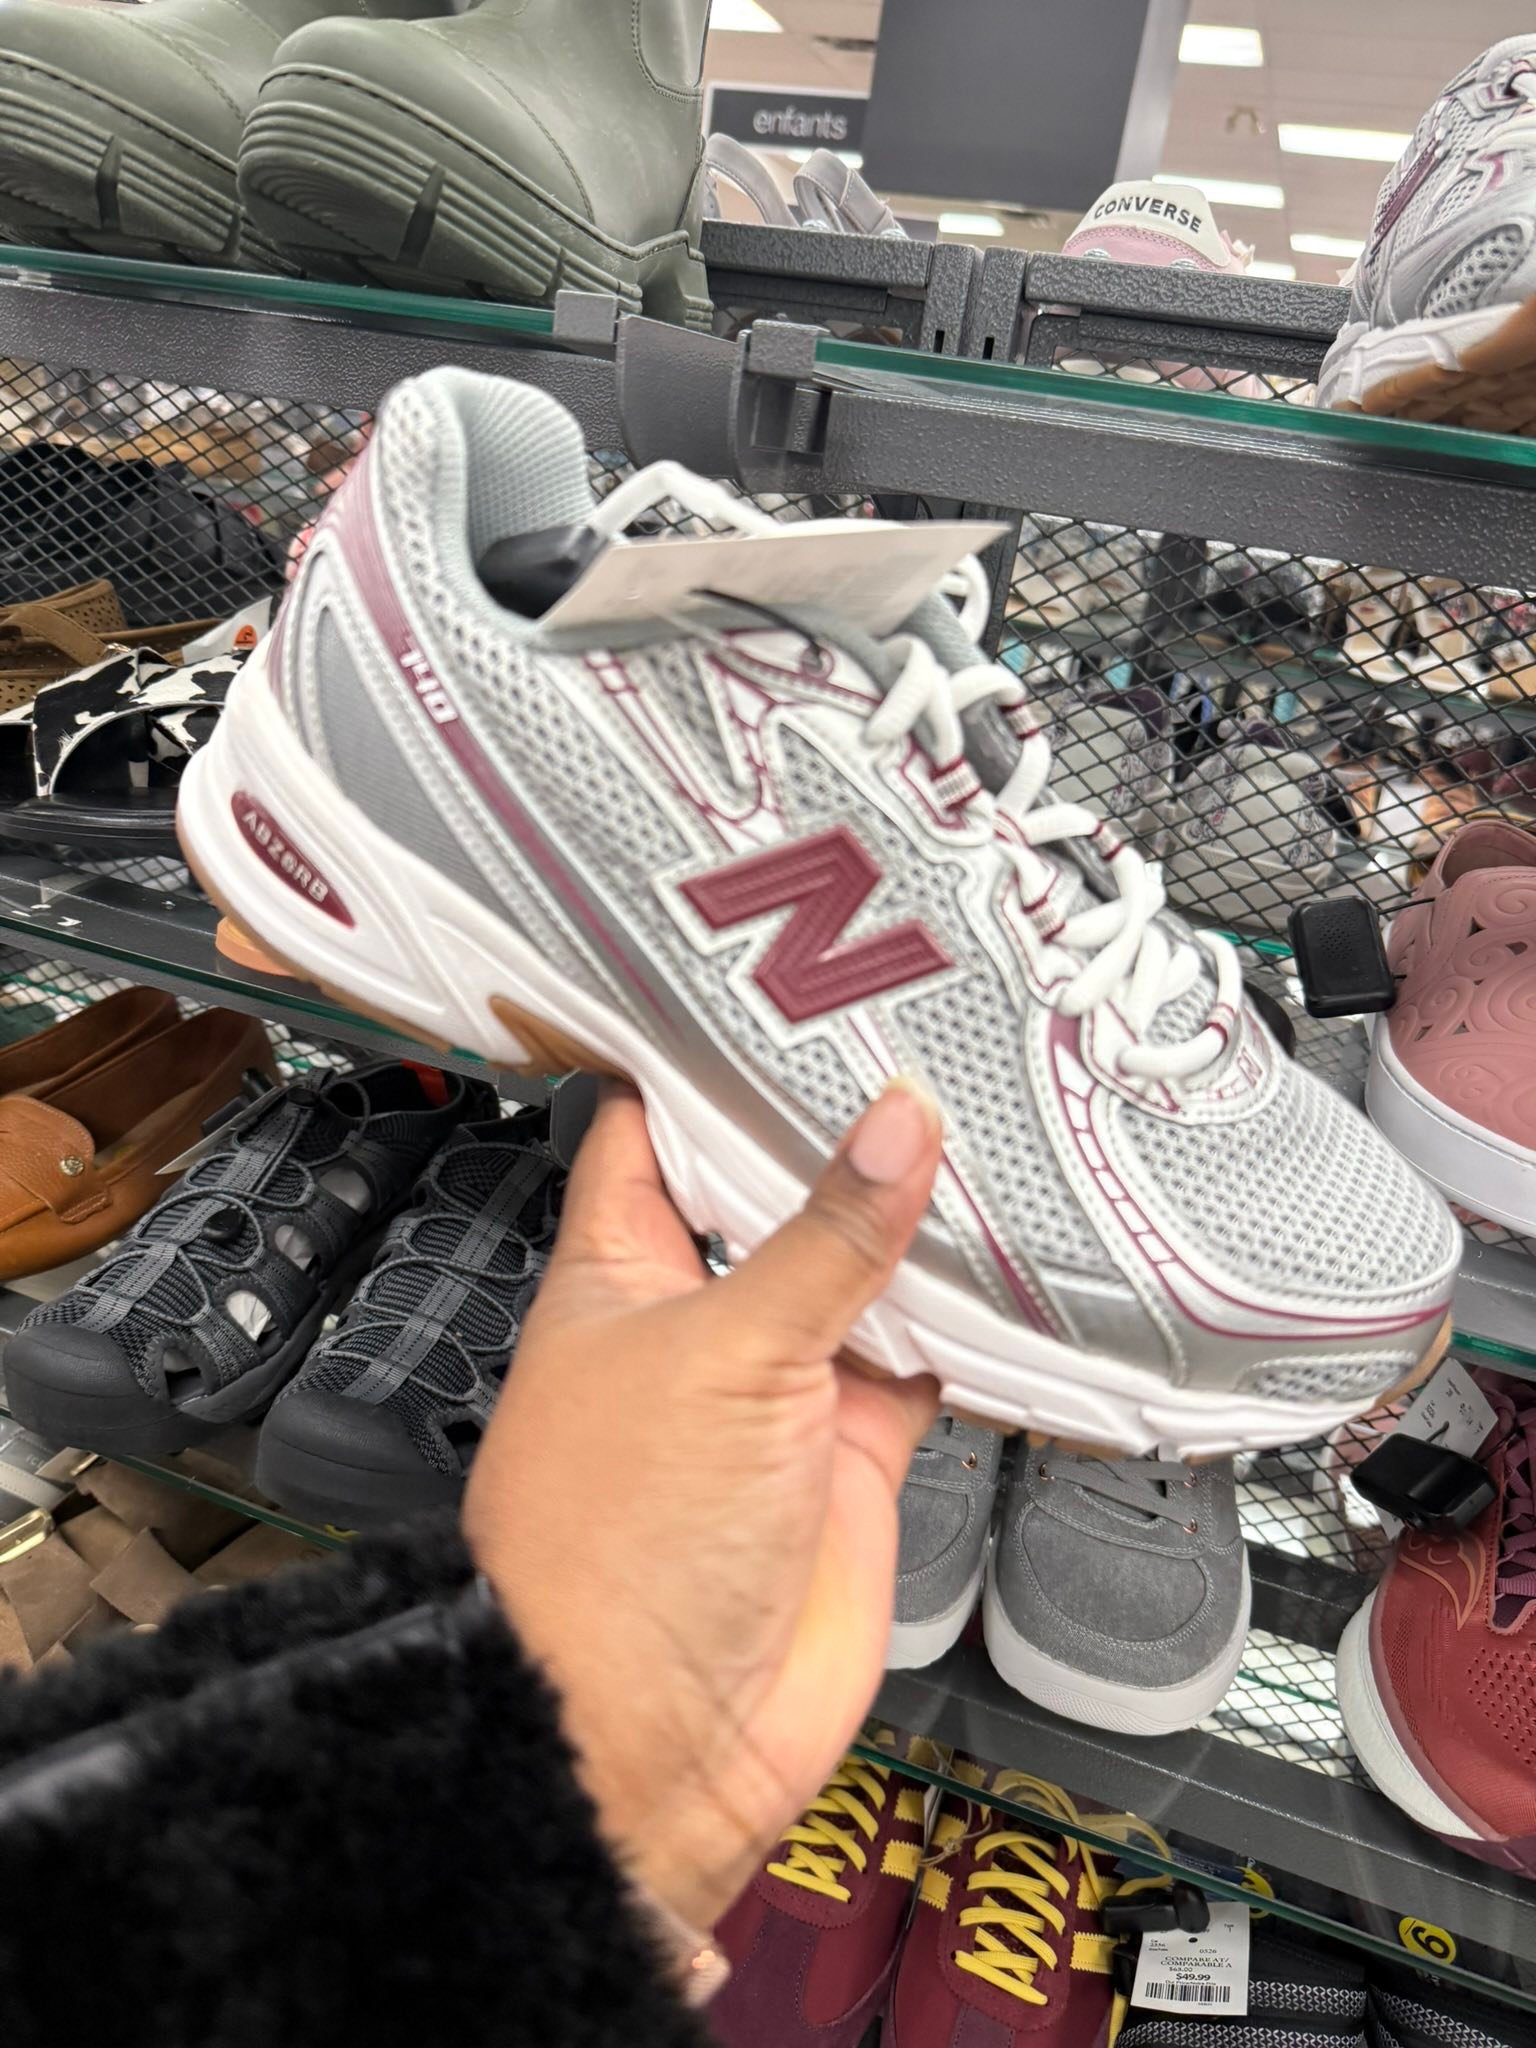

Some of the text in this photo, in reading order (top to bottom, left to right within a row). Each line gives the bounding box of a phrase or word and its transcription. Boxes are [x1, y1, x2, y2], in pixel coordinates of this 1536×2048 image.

[752, 105, 848, 141] enfants
[1093, 195, 1202, 234] CONVERSE
[241, 810, 329, 903] ABZORB
[1160, 1960, 1224, 1968] COMPARABLE
[1175, 1973, 1211, 1981] $49.99
